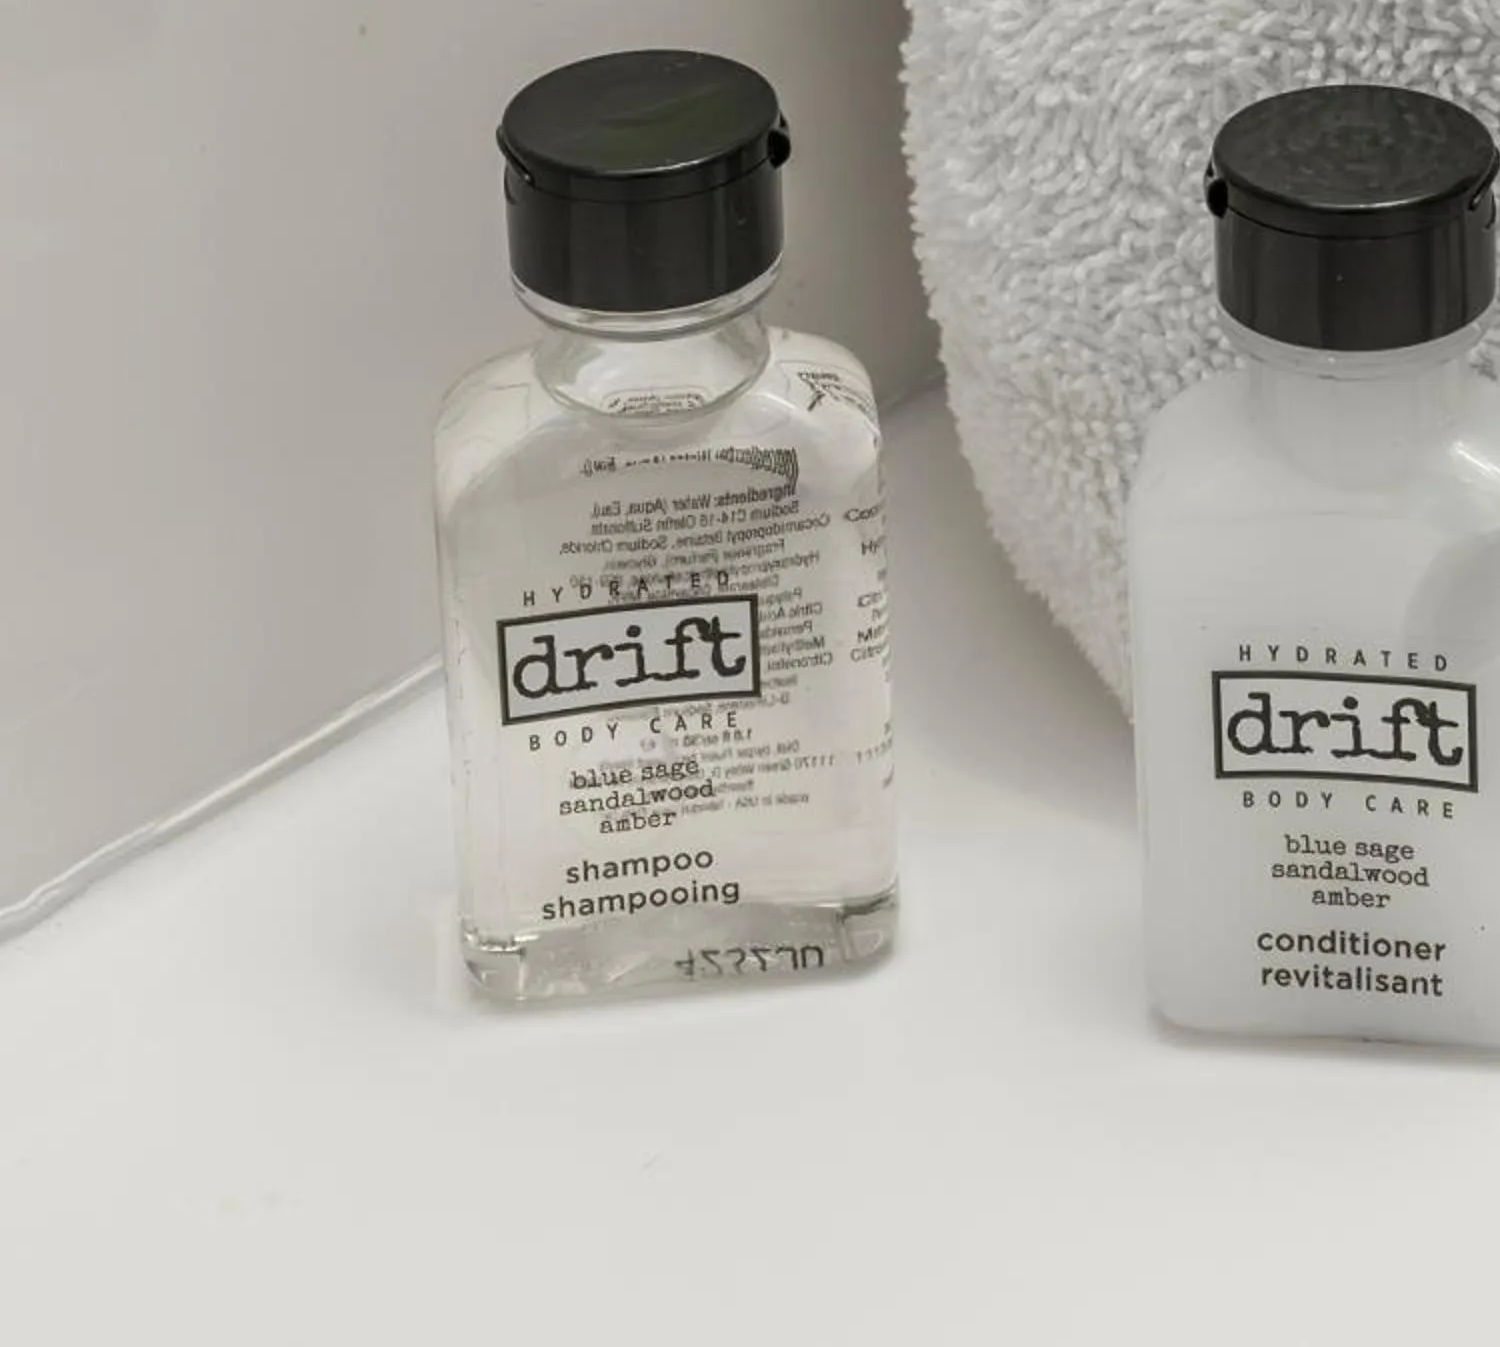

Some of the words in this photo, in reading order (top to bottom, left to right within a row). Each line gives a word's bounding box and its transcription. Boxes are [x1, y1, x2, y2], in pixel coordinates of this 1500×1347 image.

[522, 570, 731, 607] HYDRATED
[512, 616, 747, 701] drift
[1238, 644, 1449, 673] HYDRATED
[528, 721, 620, 752] BODY
[649, 710, 739, 736] CARE
[1227, 691, 1464, 767] drift
[570, 769, 633, 791] blue
[641, 758, 700, 783] sage
[559, 779, 715, 816] sandalwood
[1243, 790, 1333, 810] BODY
[1365, 794, 1455, 820] CARE
[599, 811, 677, 835] amber
[1284, 834, 1347, 857] blue
[1355, 839, 1415, 864] sage
[565, 850, 714, 885] shampoo
[1271, 861, 1431, 888] sandalwood
[542, 879, 741, 921] shampooing
[1311, 886, 1391, 909] amber
[1256, 929, 1447, 962] conditioner
[1260, 963, 1444, 997] revitalisant
